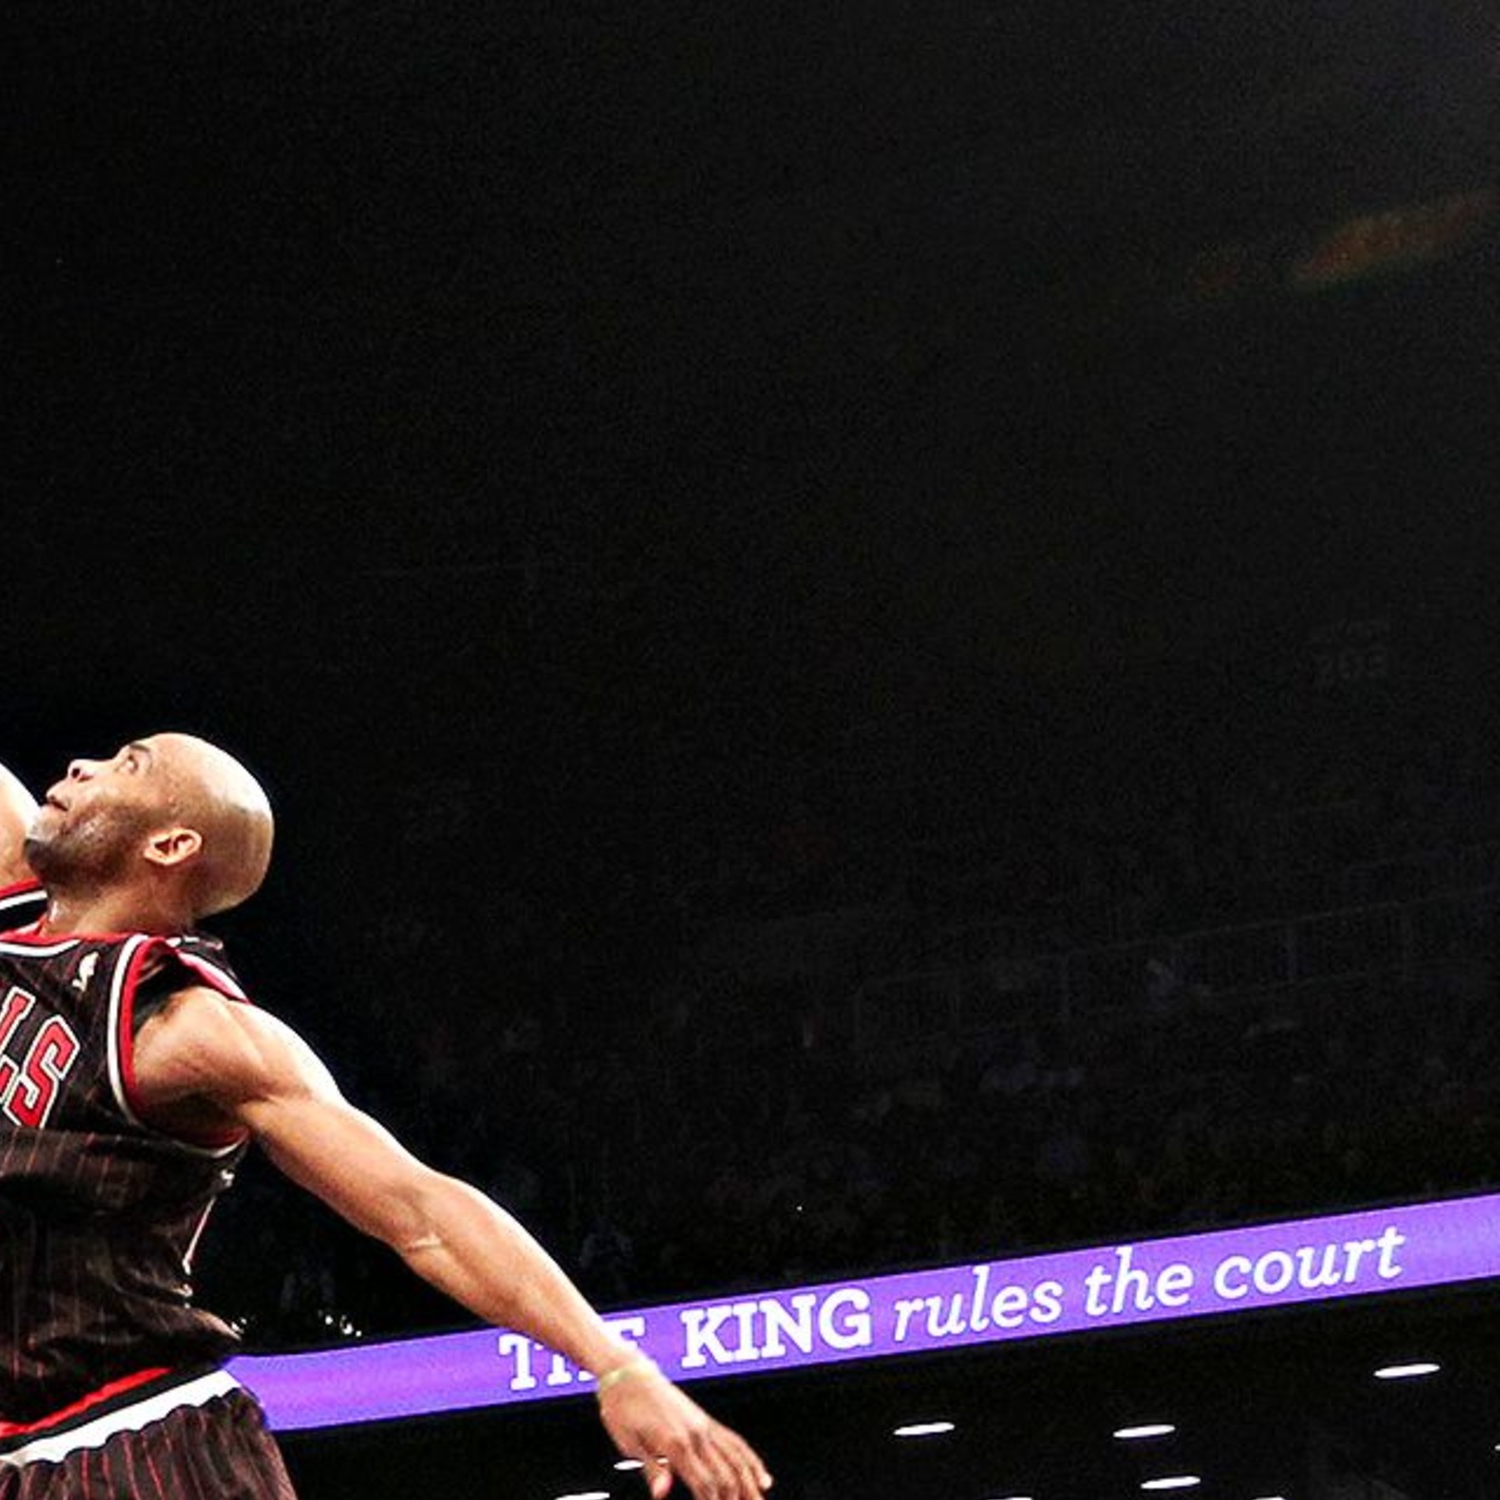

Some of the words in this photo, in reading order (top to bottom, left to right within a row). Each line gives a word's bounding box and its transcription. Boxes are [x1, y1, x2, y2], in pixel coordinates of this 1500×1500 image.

[679, 1288, 871, 1369] KING
[893, 1265, 1064, 1342] rules
[1084, 1246, 1194, 1316] the
[1213, 1226, 1405, 1299] court
